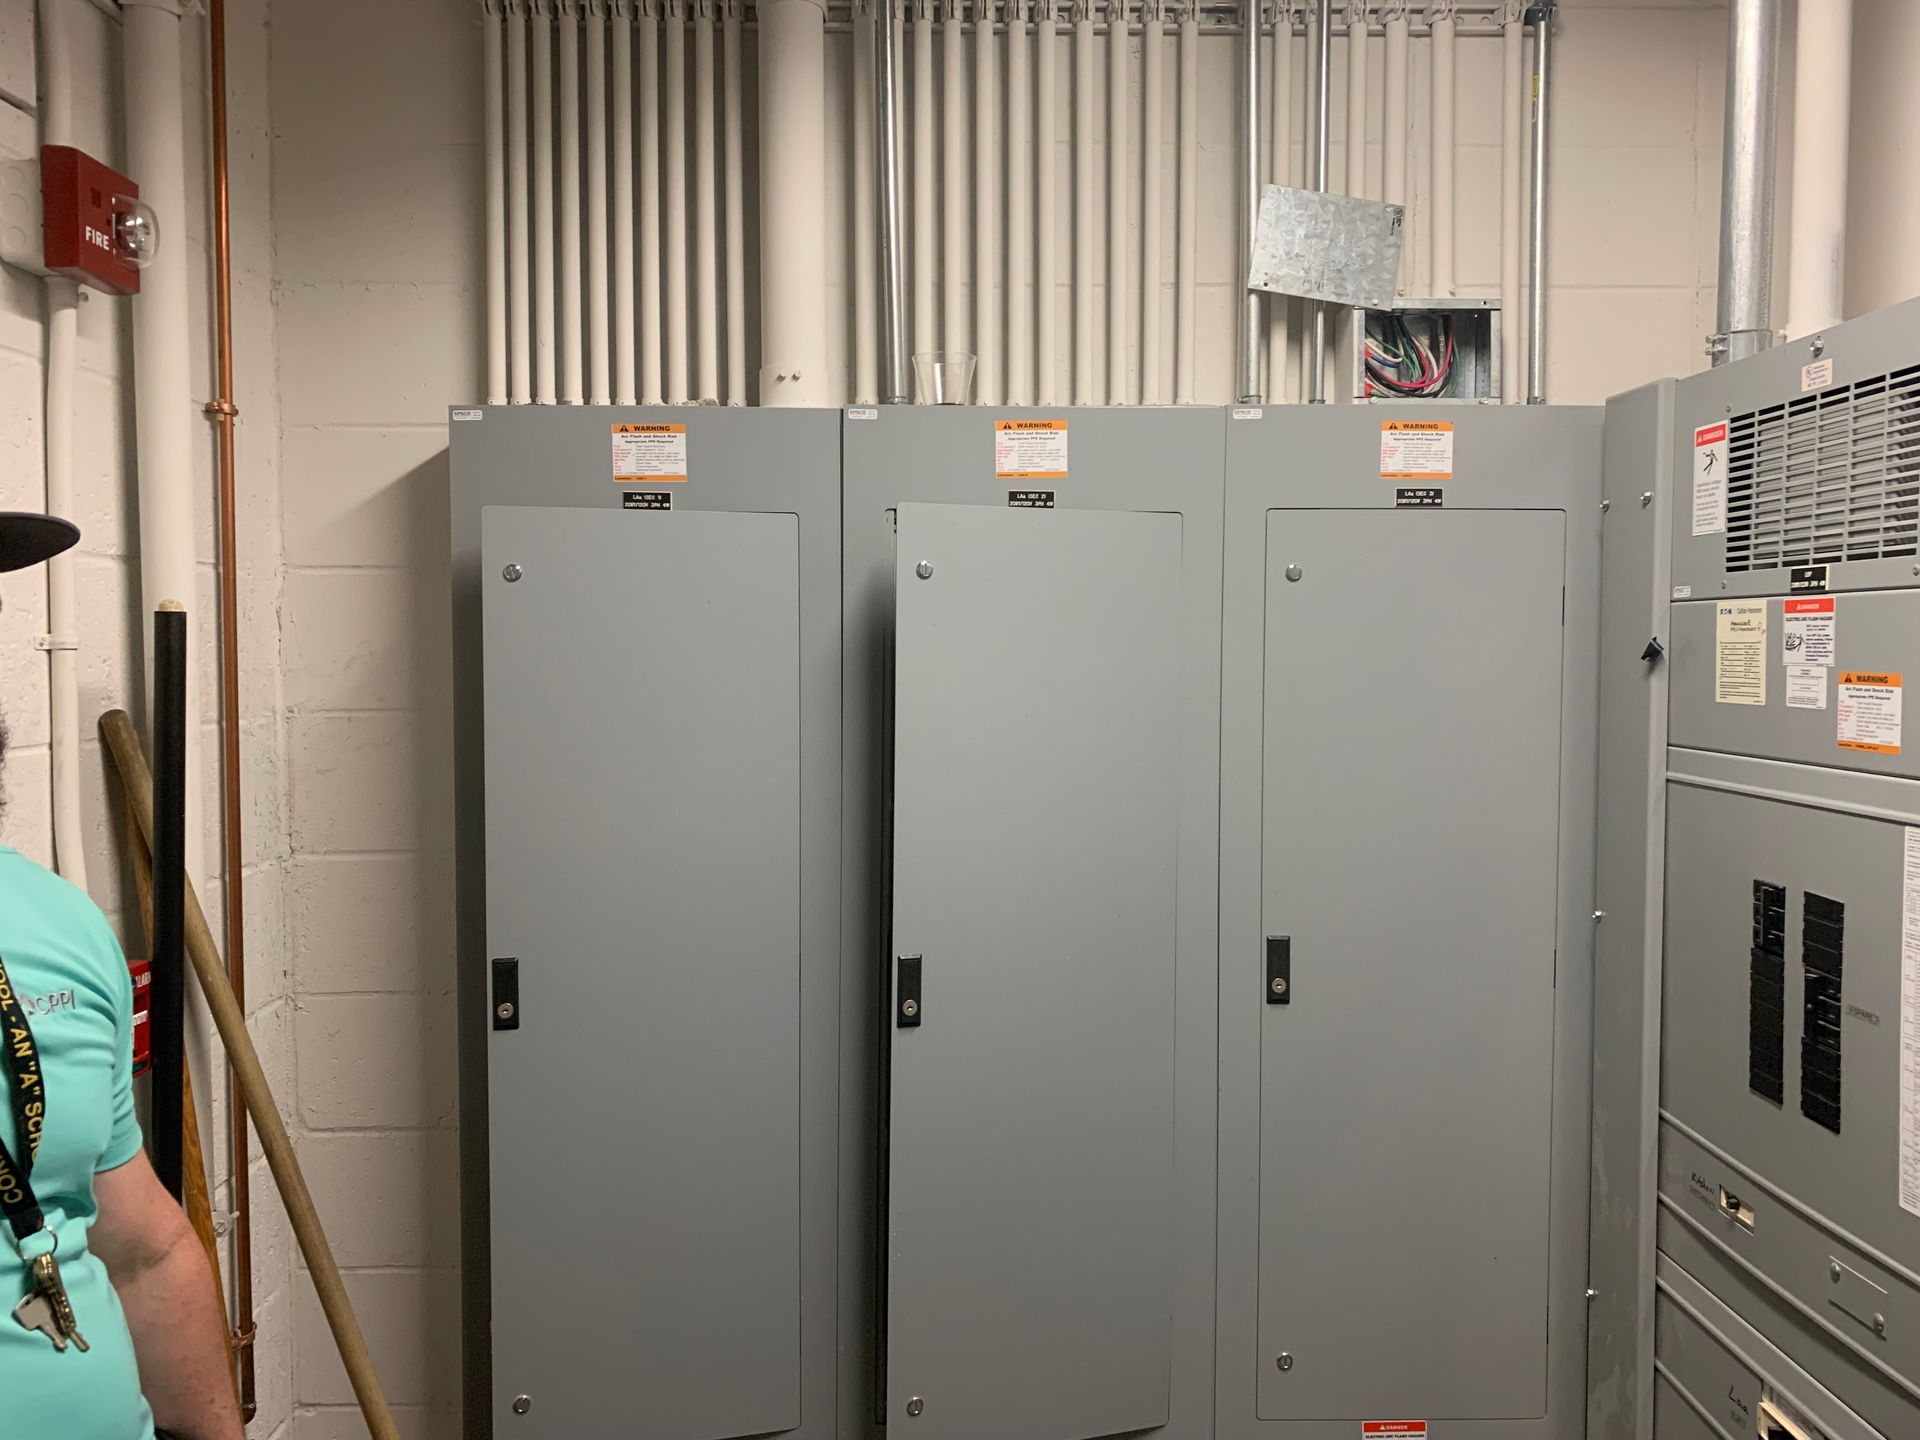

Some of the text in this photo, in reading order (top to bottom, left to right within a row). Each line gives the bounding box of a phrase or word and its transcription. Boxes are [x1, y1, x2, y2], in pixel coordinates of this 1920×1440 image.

[85, 225, 110, 251] FIRE
[1856, 675, 1889, 684] WARNING
[10, 1028, 33, 1058] AN
[19, 1061, 41, 1095] "A"
